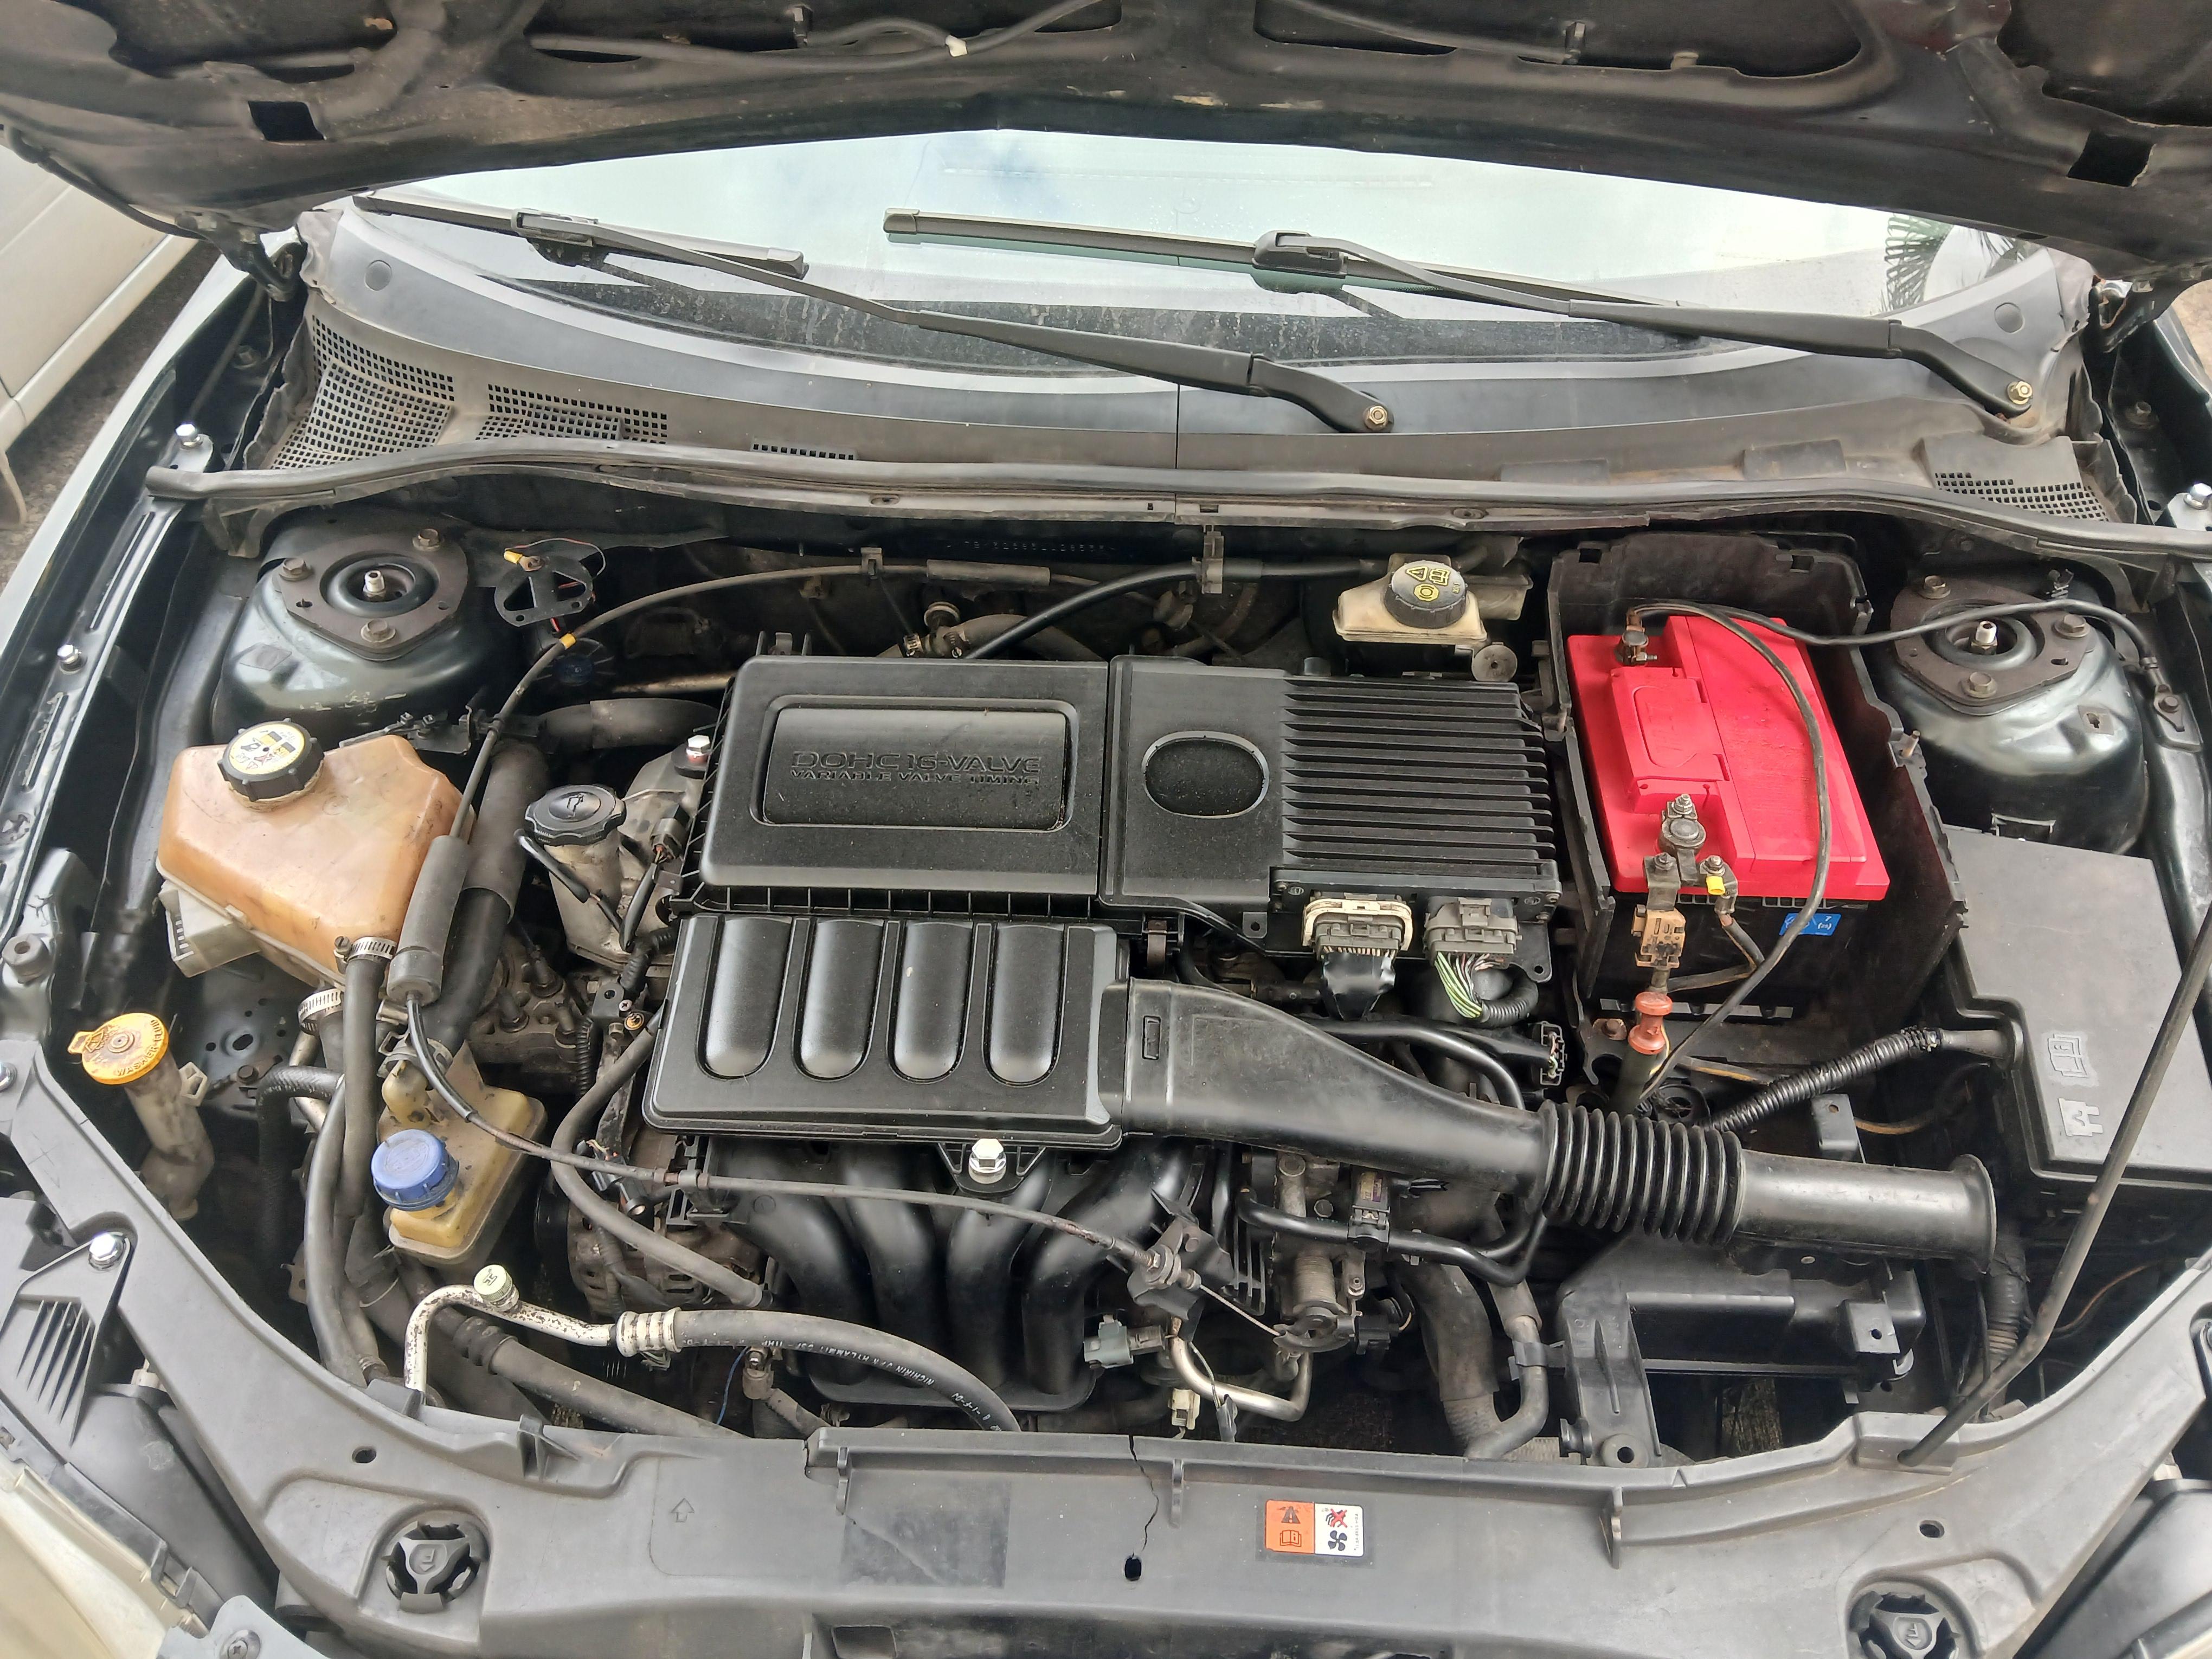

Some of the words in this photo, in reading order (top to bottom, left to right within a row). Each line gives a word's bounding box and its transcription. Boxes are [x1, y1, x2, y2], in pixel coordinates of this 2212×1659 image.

[791, 750, 901, 770] DOHC
[907, 753, 1041, 774] 16-VALVE
[790, 769, 891, 781] VARIABLE
[898, 771, 961, 783] VALVE
[968, 774, 1039, 785] TIMING
[117, 1044, 159, 1077] WASHER
[150, 1019, 163, 1042] FLUID
[896, 1365, 935, 1385] NICHIRIN
